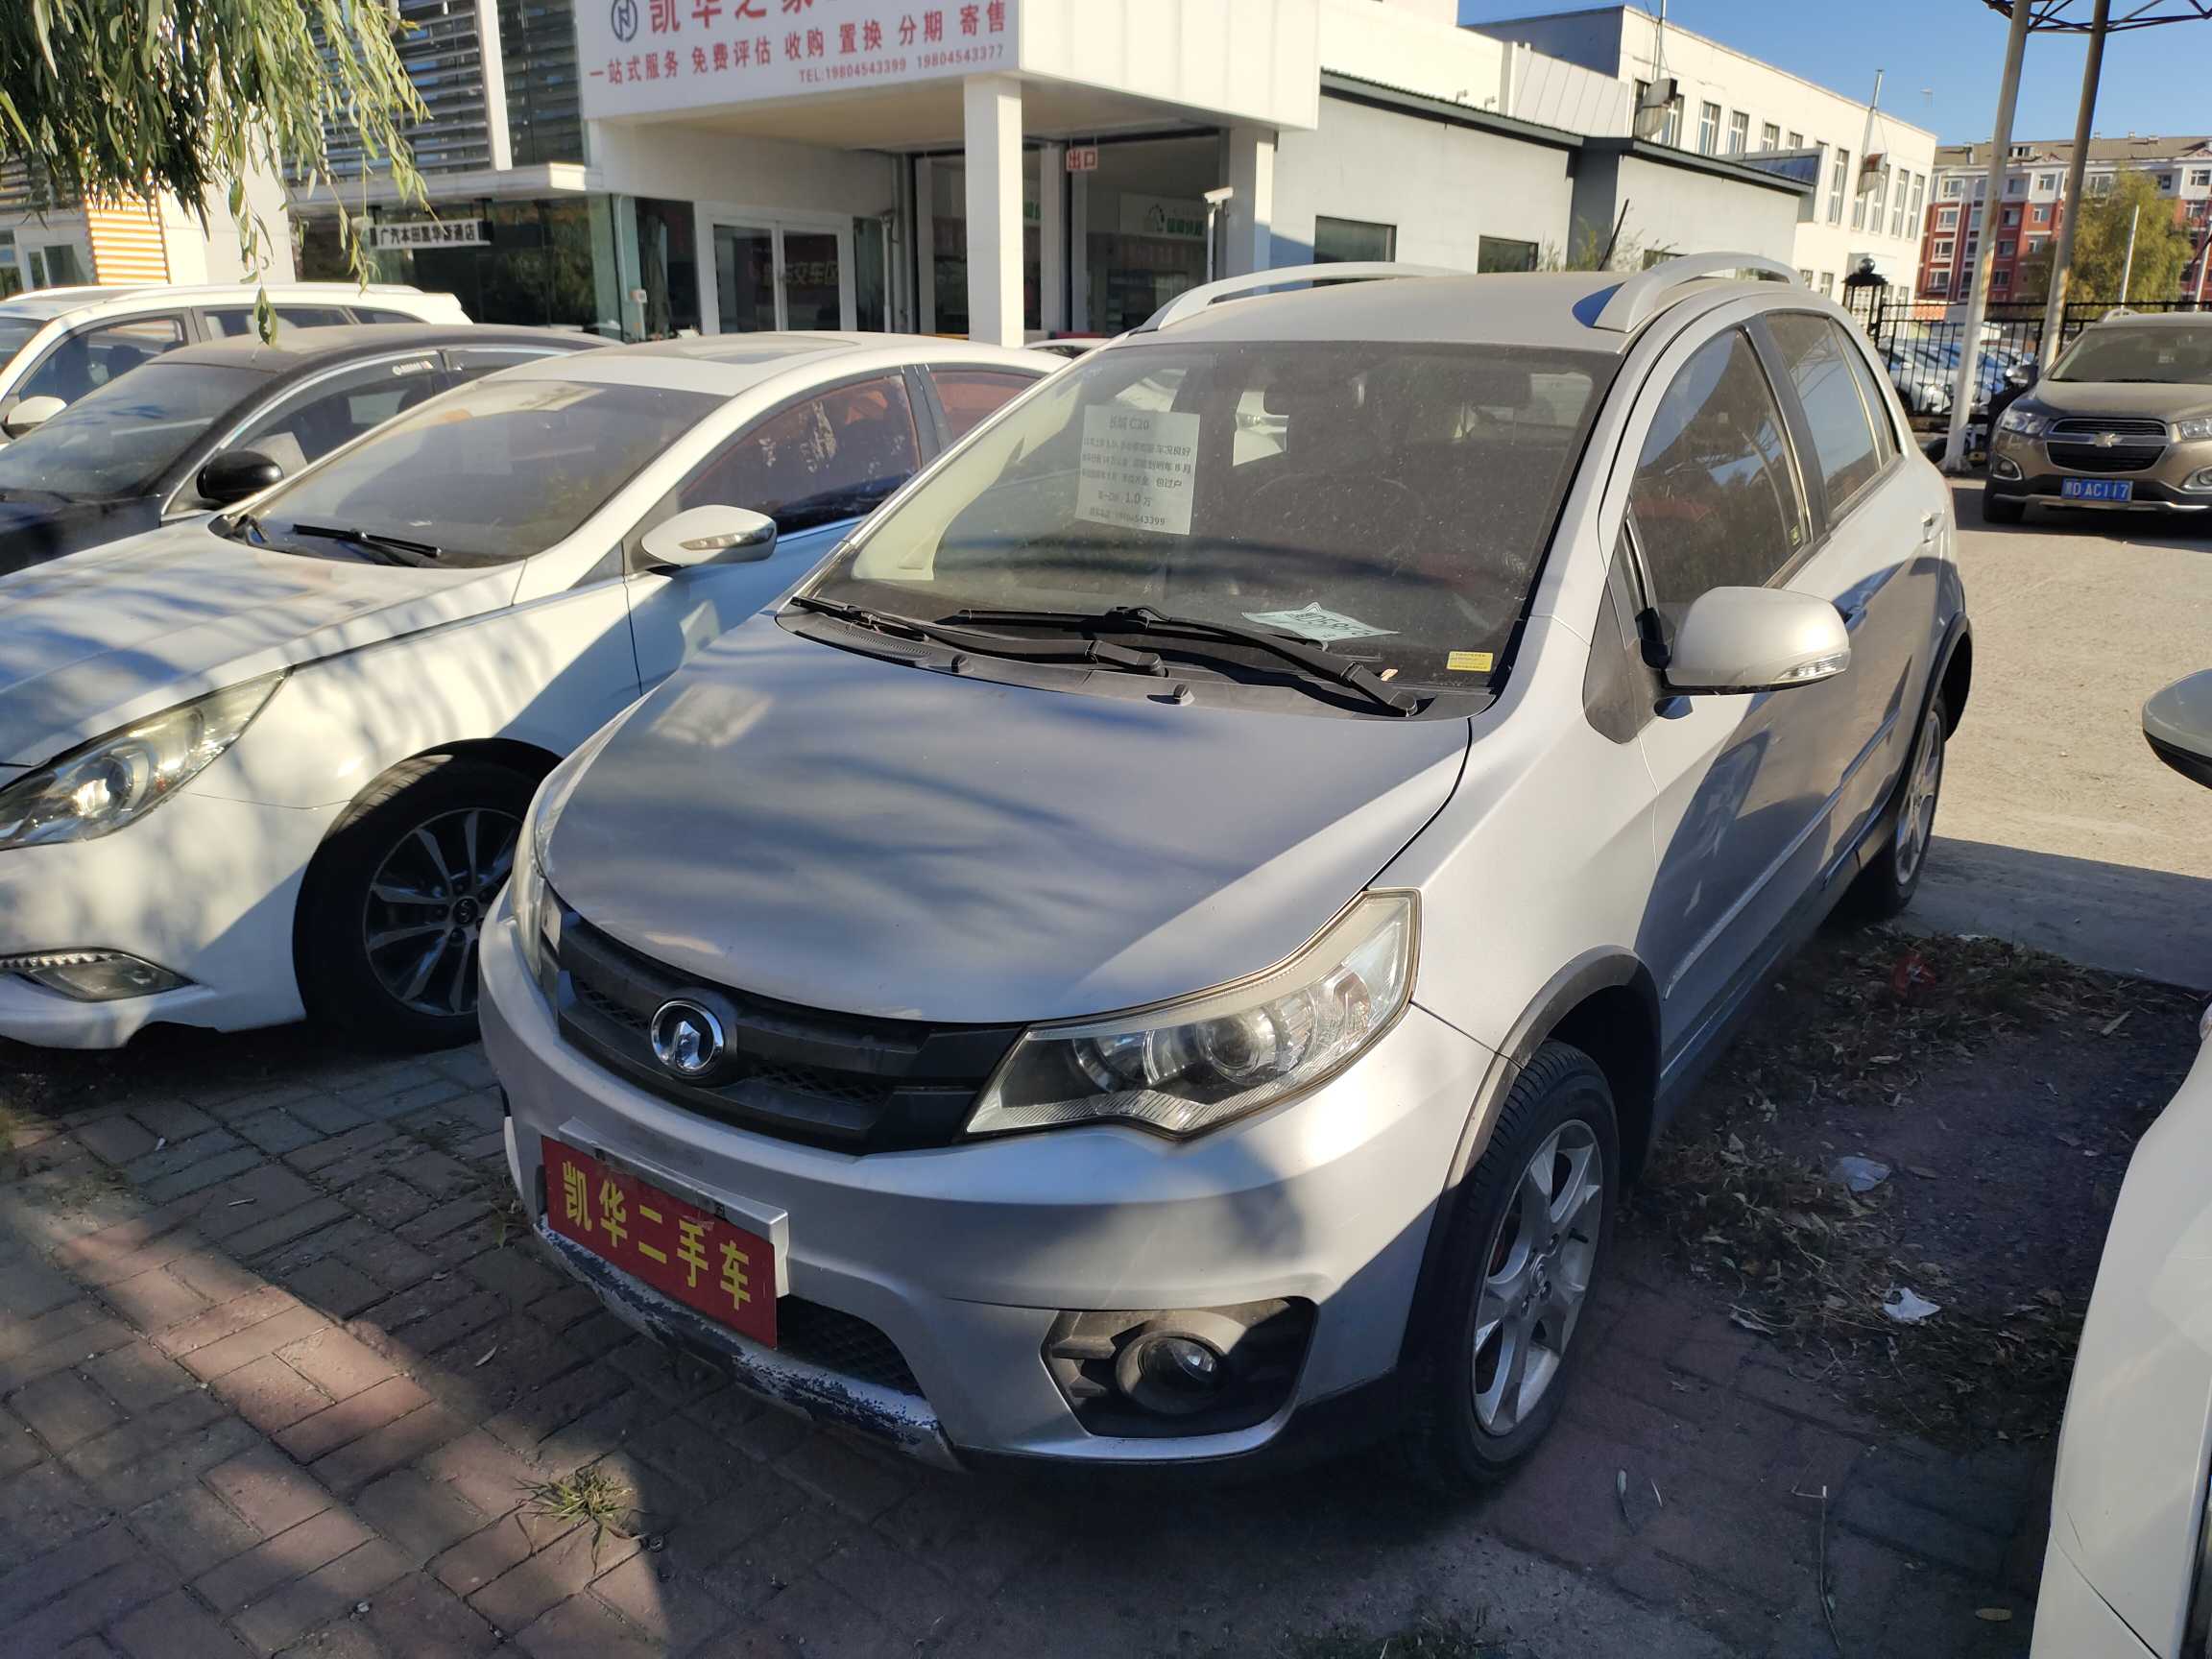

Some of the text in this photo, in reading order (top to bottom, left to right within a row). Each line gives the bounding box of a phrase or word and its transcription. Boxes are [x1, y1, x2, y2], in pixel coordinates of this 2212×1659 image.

[589, 0, 1005, 84] 一站式服务 免费评估 收购 置换 分期 寄售
[917, 44, 1004, 69] 19804543377
[1068, 149, 1096, 169] 出口
[563, 1161, 751, 1311] 凯华二手车
